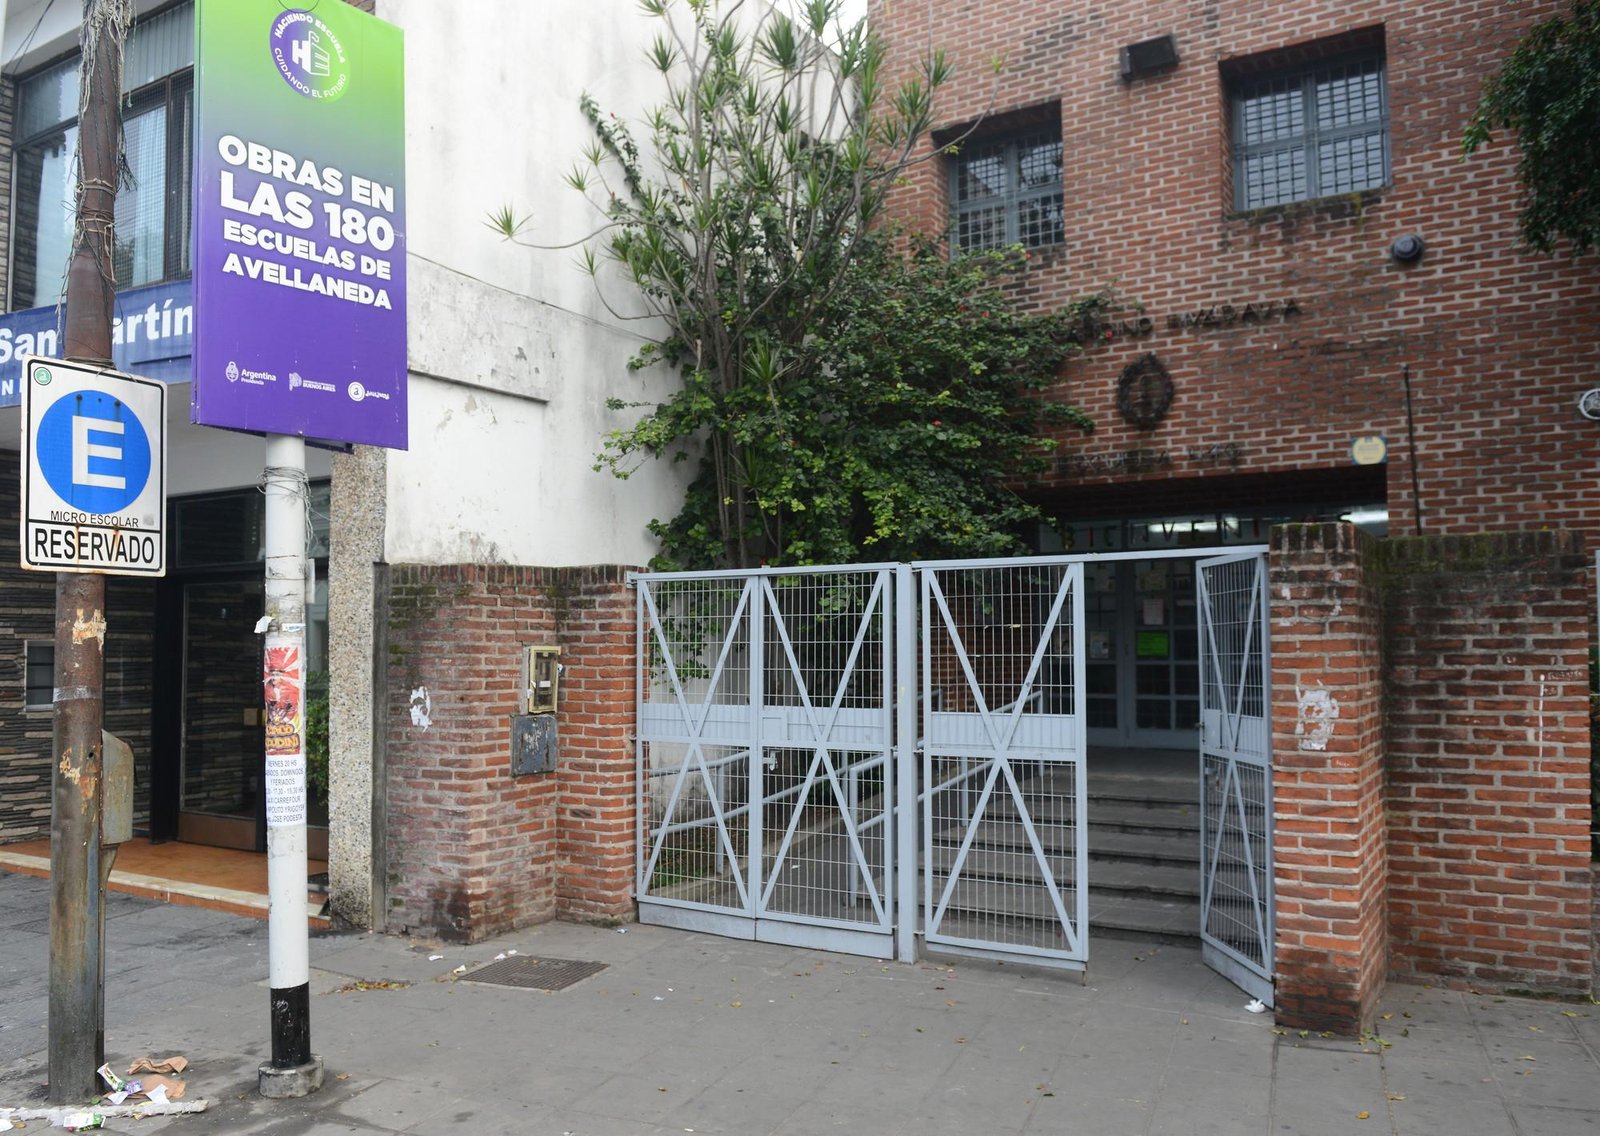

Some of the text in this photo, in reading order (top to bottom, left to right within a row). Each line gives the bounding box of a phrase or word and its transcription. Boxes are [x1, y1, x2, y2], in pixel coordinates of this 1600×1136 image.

[274, 13, 345, 64] HACIENDO ESCUELA
[274, 47, 346, 98] CUIDANDO EL FUTURO
[218, 135, 394, 213] OBRAS EN
[220, 170, 395, 252] LAS 180
[223, 219, 391, 280] ESCUELAS DE
[222, 252, 392, 310] AVELLANEDA
[0, 298, 192, 364] San artín
[242, 368, 277, 382] Argentina
[72, 415, 126, 489] E
[35, 528, 155, 563] RESERVADO
[50, 510, 139, 528] MICRO ESCOLAR
